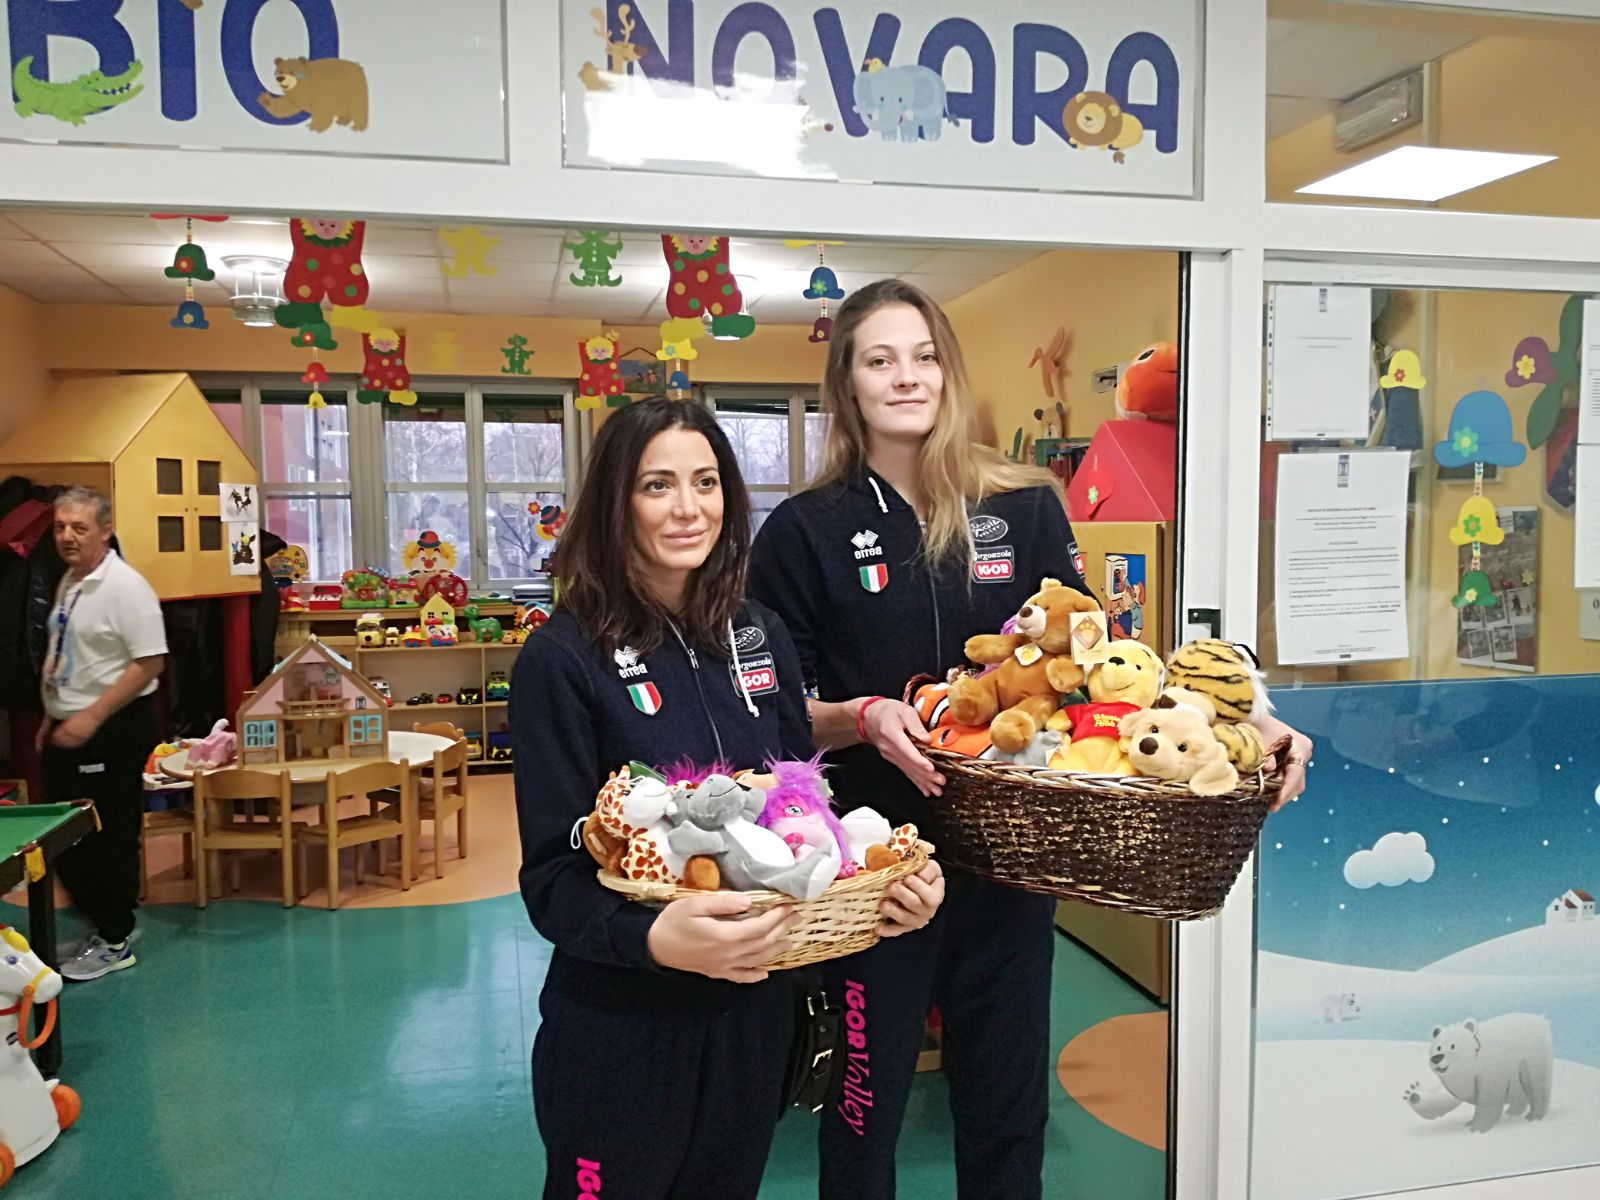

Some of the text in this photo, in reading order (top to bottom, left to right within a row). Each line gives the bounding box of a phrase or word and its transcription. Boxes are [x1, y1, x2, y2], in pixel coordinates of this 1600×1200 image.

[604, 0, 1180, 153] NOVARA
[977, 563, 1009, 576] IGOR
[741, 672, 771, 688] GOR
[837, 979, 874, 1136] IGOR Volley
